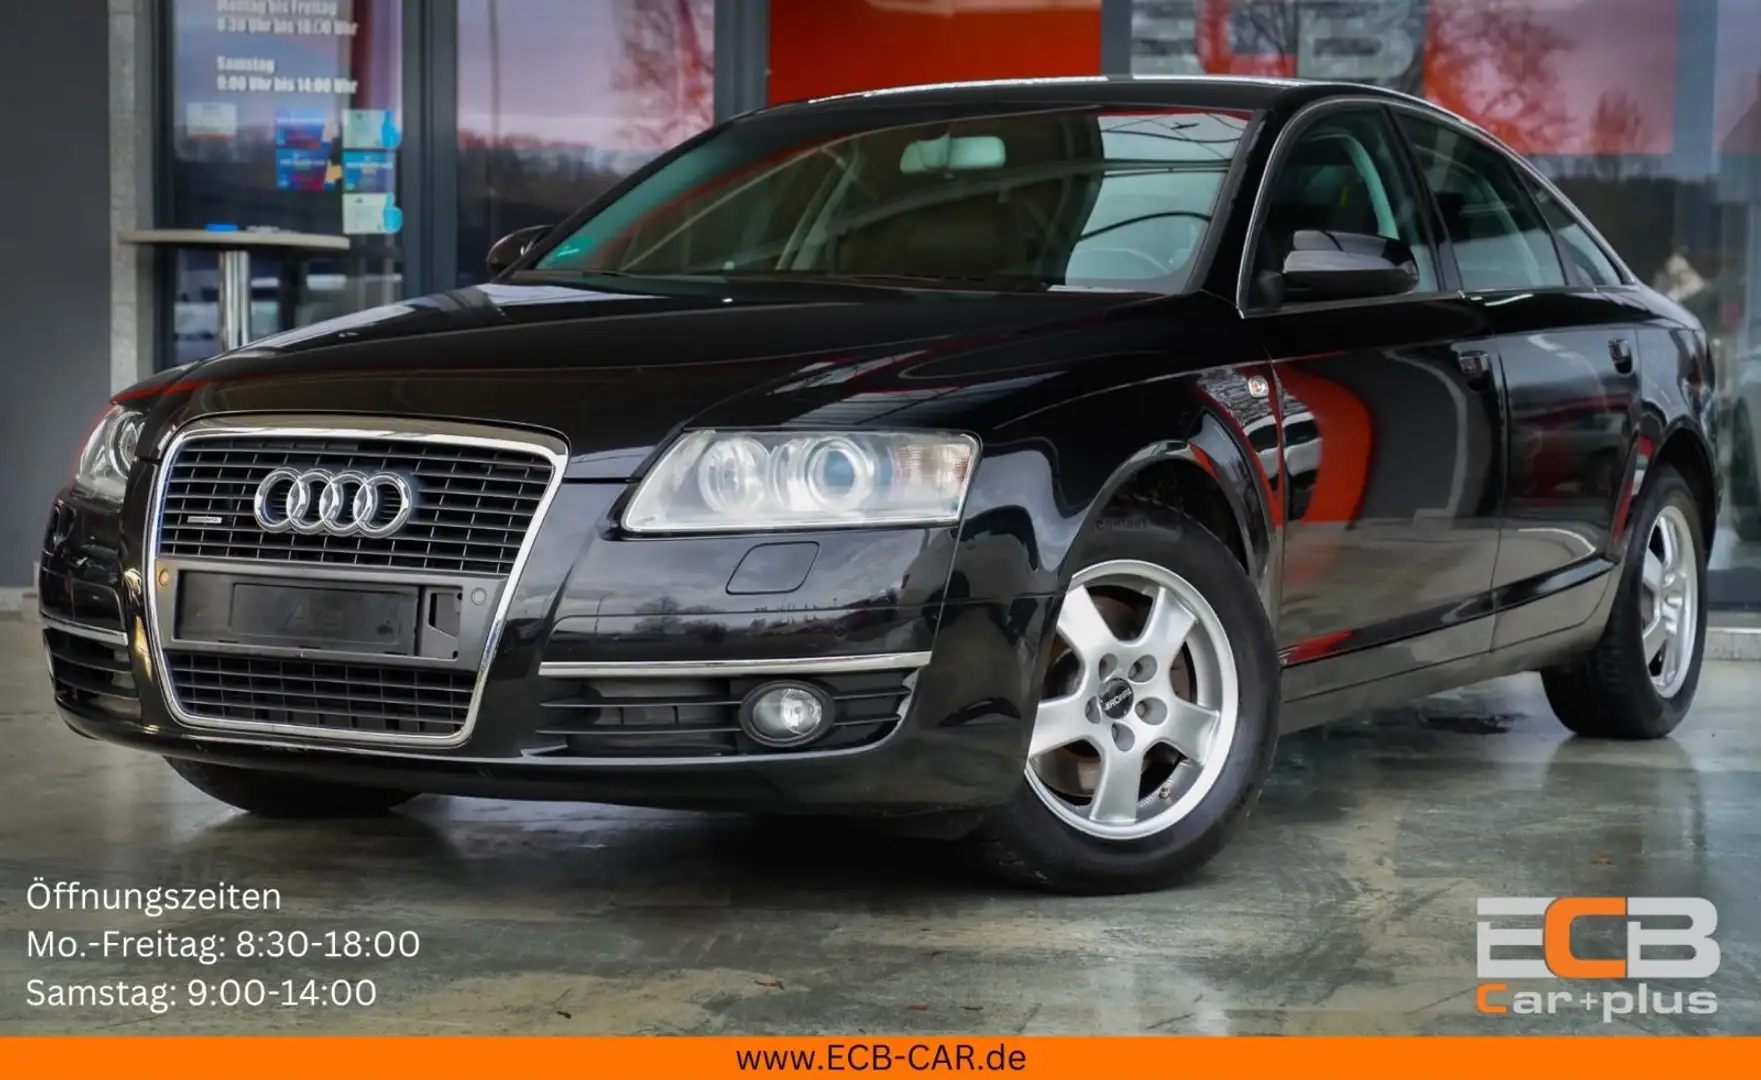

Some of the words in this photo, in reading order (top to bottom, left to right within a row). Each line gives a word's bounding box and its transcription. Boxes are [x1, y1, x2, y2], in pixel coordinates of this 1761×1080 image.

[217, 56, 275, 74] Samstag
[248, 76, 272, 92] Uhr
[273, 77, 295, 92] bis
[297, 77, 332, 93] 14:00
[333, 78, 358, 94] Uhr
